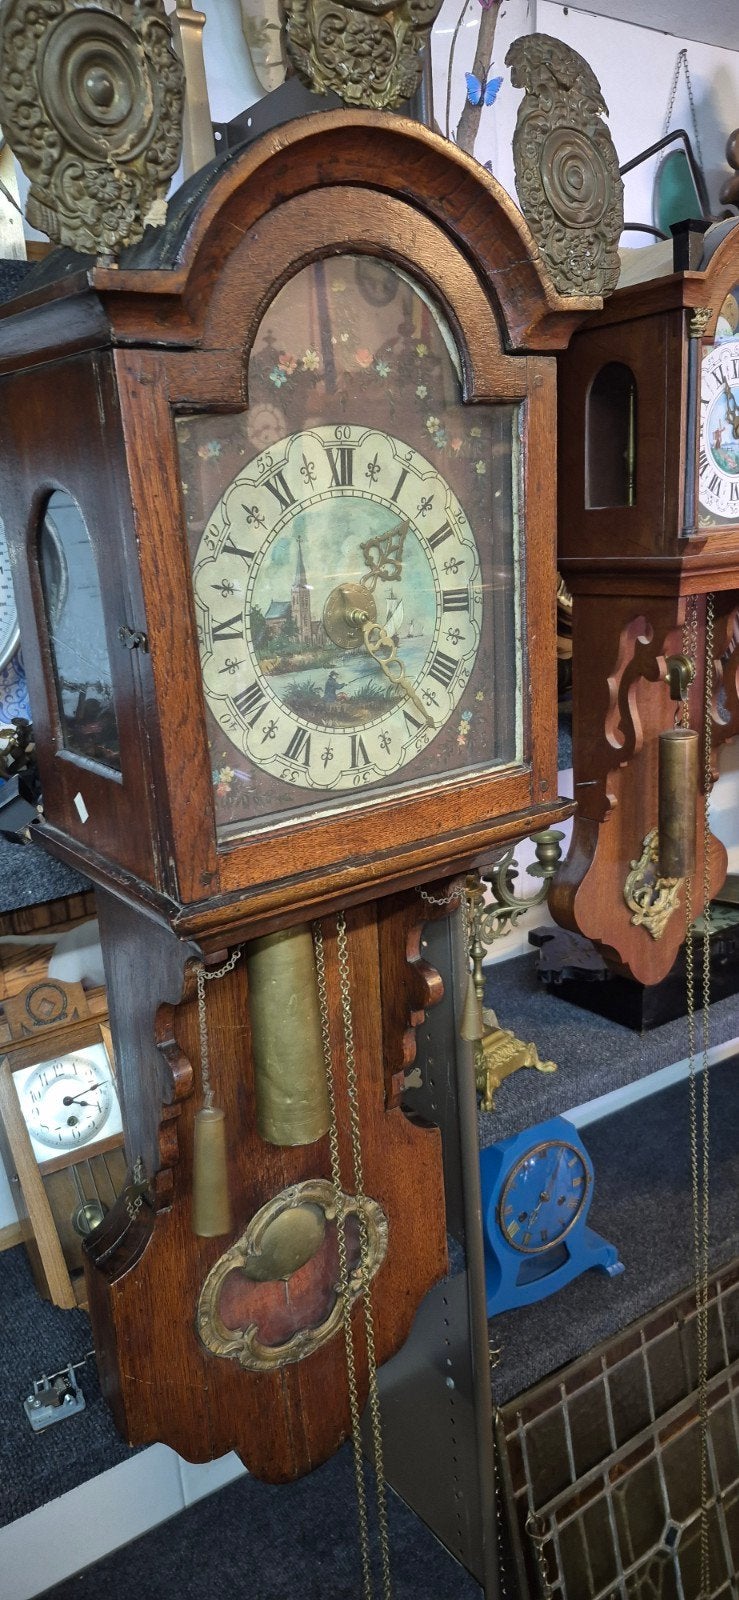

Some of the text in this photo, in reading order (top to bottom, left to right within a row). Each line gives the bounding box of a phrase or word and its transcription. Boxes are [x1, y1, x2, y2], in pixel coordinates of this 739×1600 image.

[334, 425, 351, 440] 60
[256, 451, 274, 474] 55
[323, 447, 356, 489] XII
[404, 450, 416, 462] 5
[261, 468, 299, 516] XI
[390, 467, 411, 504] I
[454, 508, 467, 525] 10
[203, 523, 220, 551] 50
[425, 519, 456, 553] II
[221, 532, 257, 573] X
[442, 584, 470, 615] III
[211, 611, 244, 645] IX
[426, 647, 460, 690] IIII
[458, 667, 470, 689] 20
[232, 678, 272, 729] VIII
[219, 713, 237, 733] 40
[402, 709, 425, 738] V
[283, 726, 311, 768] VII
[348, 733, 371, 769] VI
[415, 733, 430, 752] 25
[280, 768, 300, 783] 35
[353, 771, 371, 787] 30
